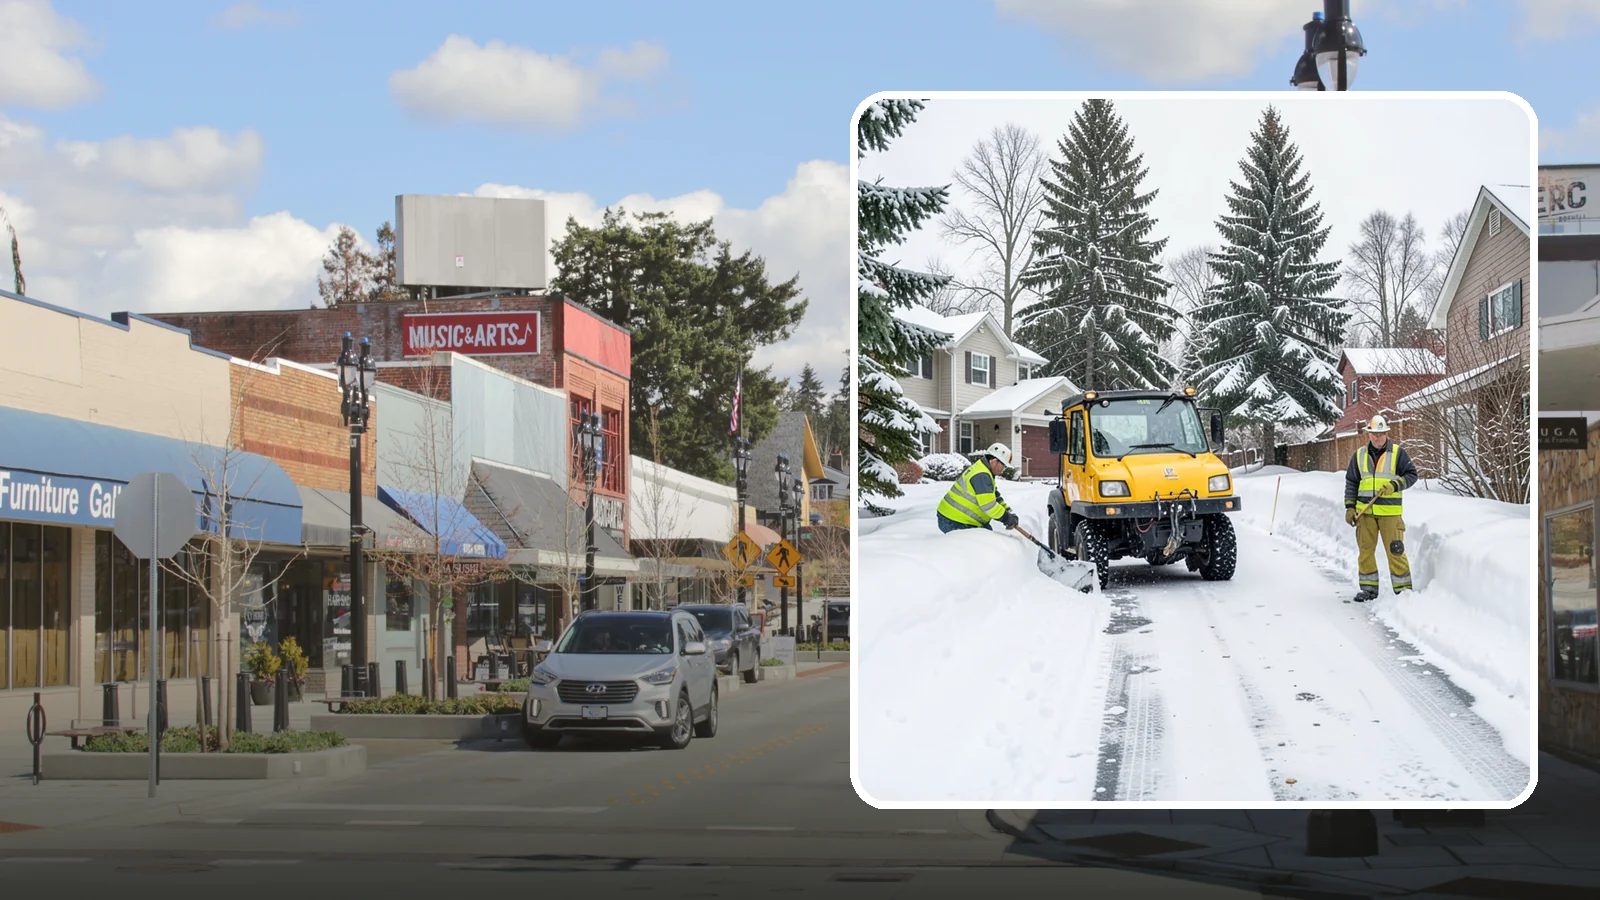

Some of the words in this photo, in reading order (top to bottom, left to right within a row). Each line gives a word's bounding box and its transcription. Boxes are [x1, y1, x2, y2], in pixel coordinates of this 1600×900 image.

[409, 323, 520, 349] MUSIC&ARTS
[0, 471, 79, 515] Furniture
[454, 562, 479, 573] SUSHI
